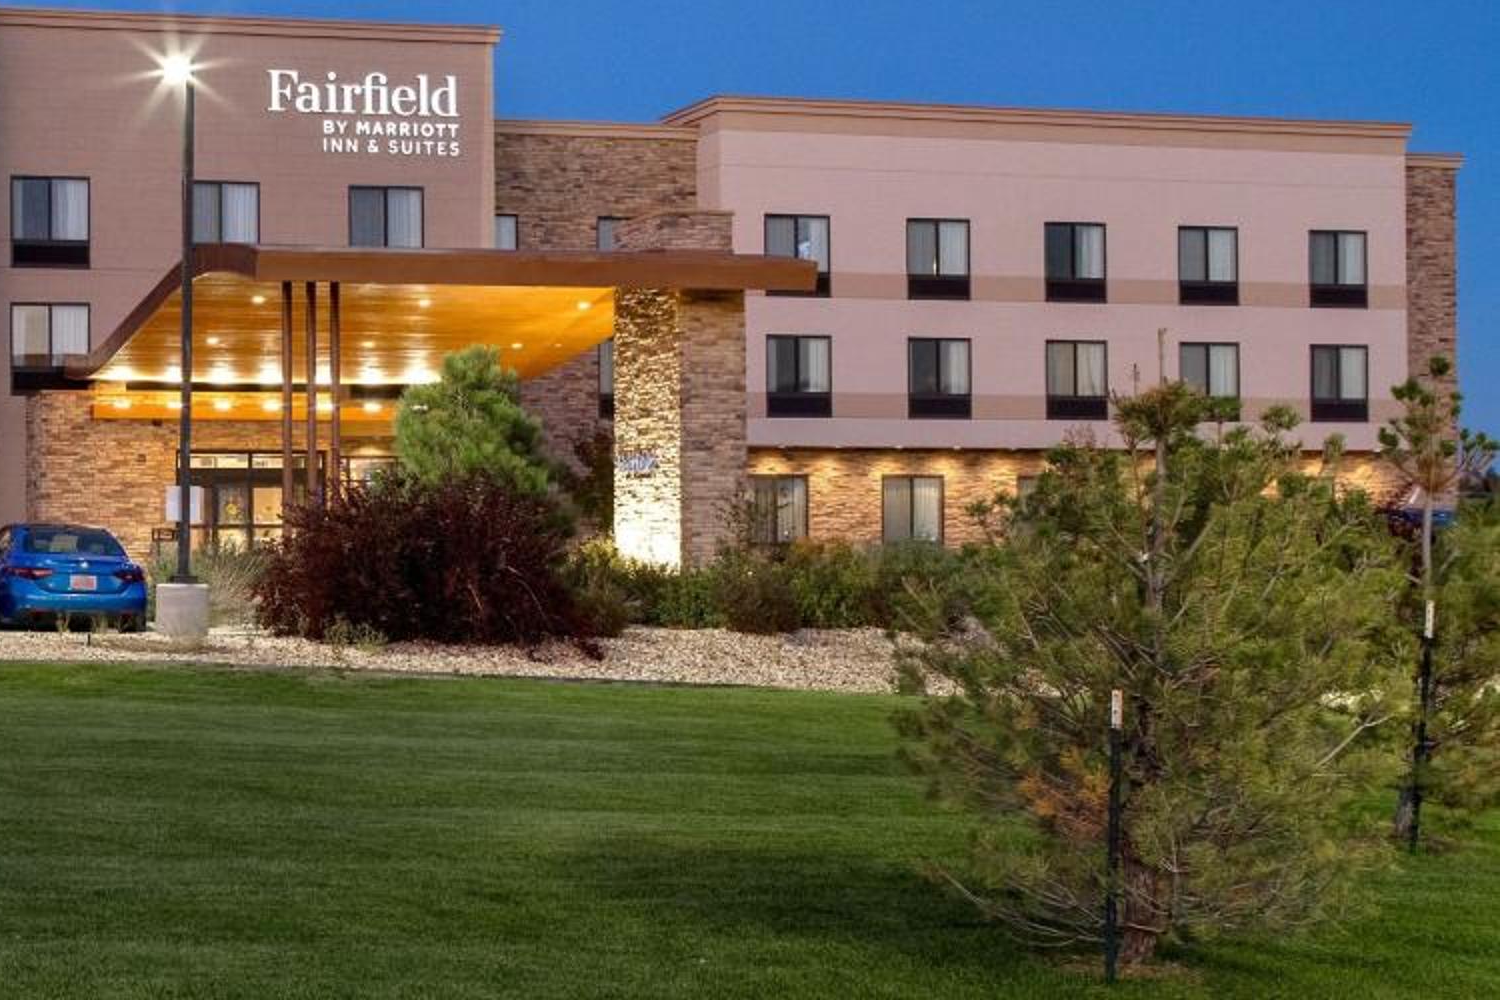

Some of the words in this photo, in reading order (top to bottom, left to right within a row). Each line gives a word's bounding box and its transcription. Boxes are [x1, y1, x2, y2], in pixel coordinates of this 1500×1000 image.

[267, 69, 460, 117] Fairfield
[323, 120, 349, 134] BY
[356, 120, 460, 138] MARRIOTT
[323, 138, 359, 153] INN
[367, 139, 380, 153] &
[388, 139, 460, 157] SUITES
